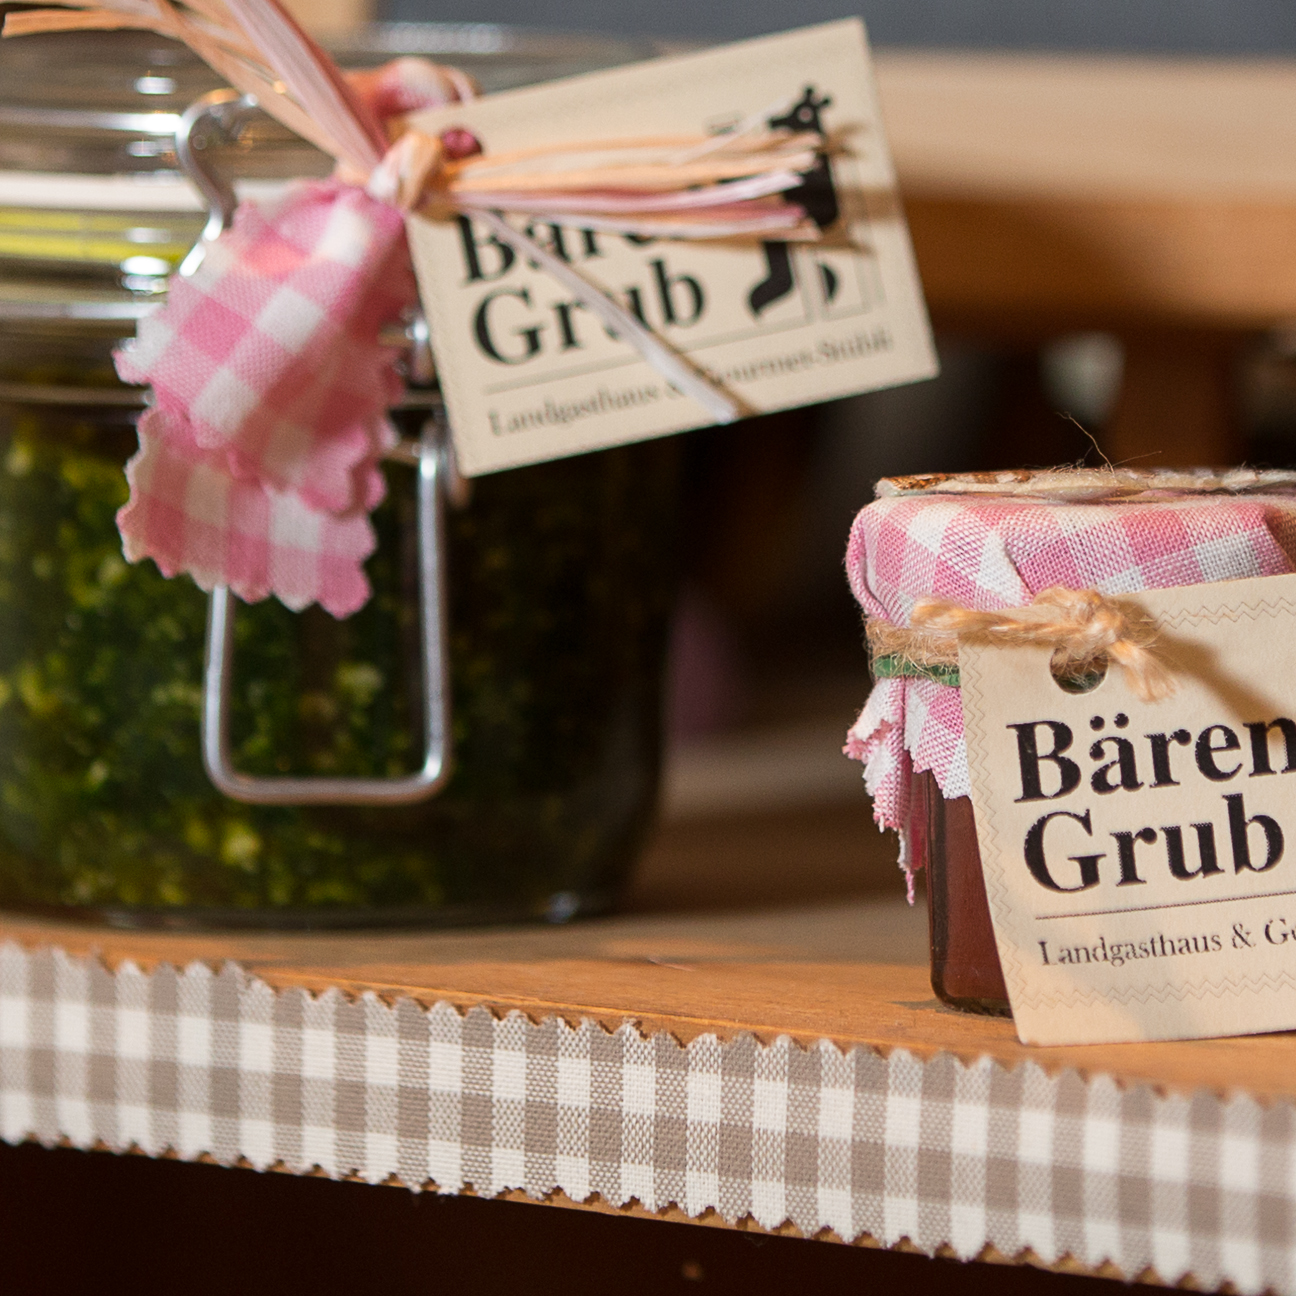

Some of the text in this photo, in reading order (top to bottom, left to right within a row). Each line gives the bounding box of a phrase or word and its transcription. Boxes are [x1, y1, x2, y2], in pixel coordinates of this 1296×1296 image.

[487, 383, 660, 438] Landgasthaus
[1022, 793, 1286, 895] Grub
[1037, 928, 1223, 969] Landgasthaus
[1231, 923, 1257, 949] &
